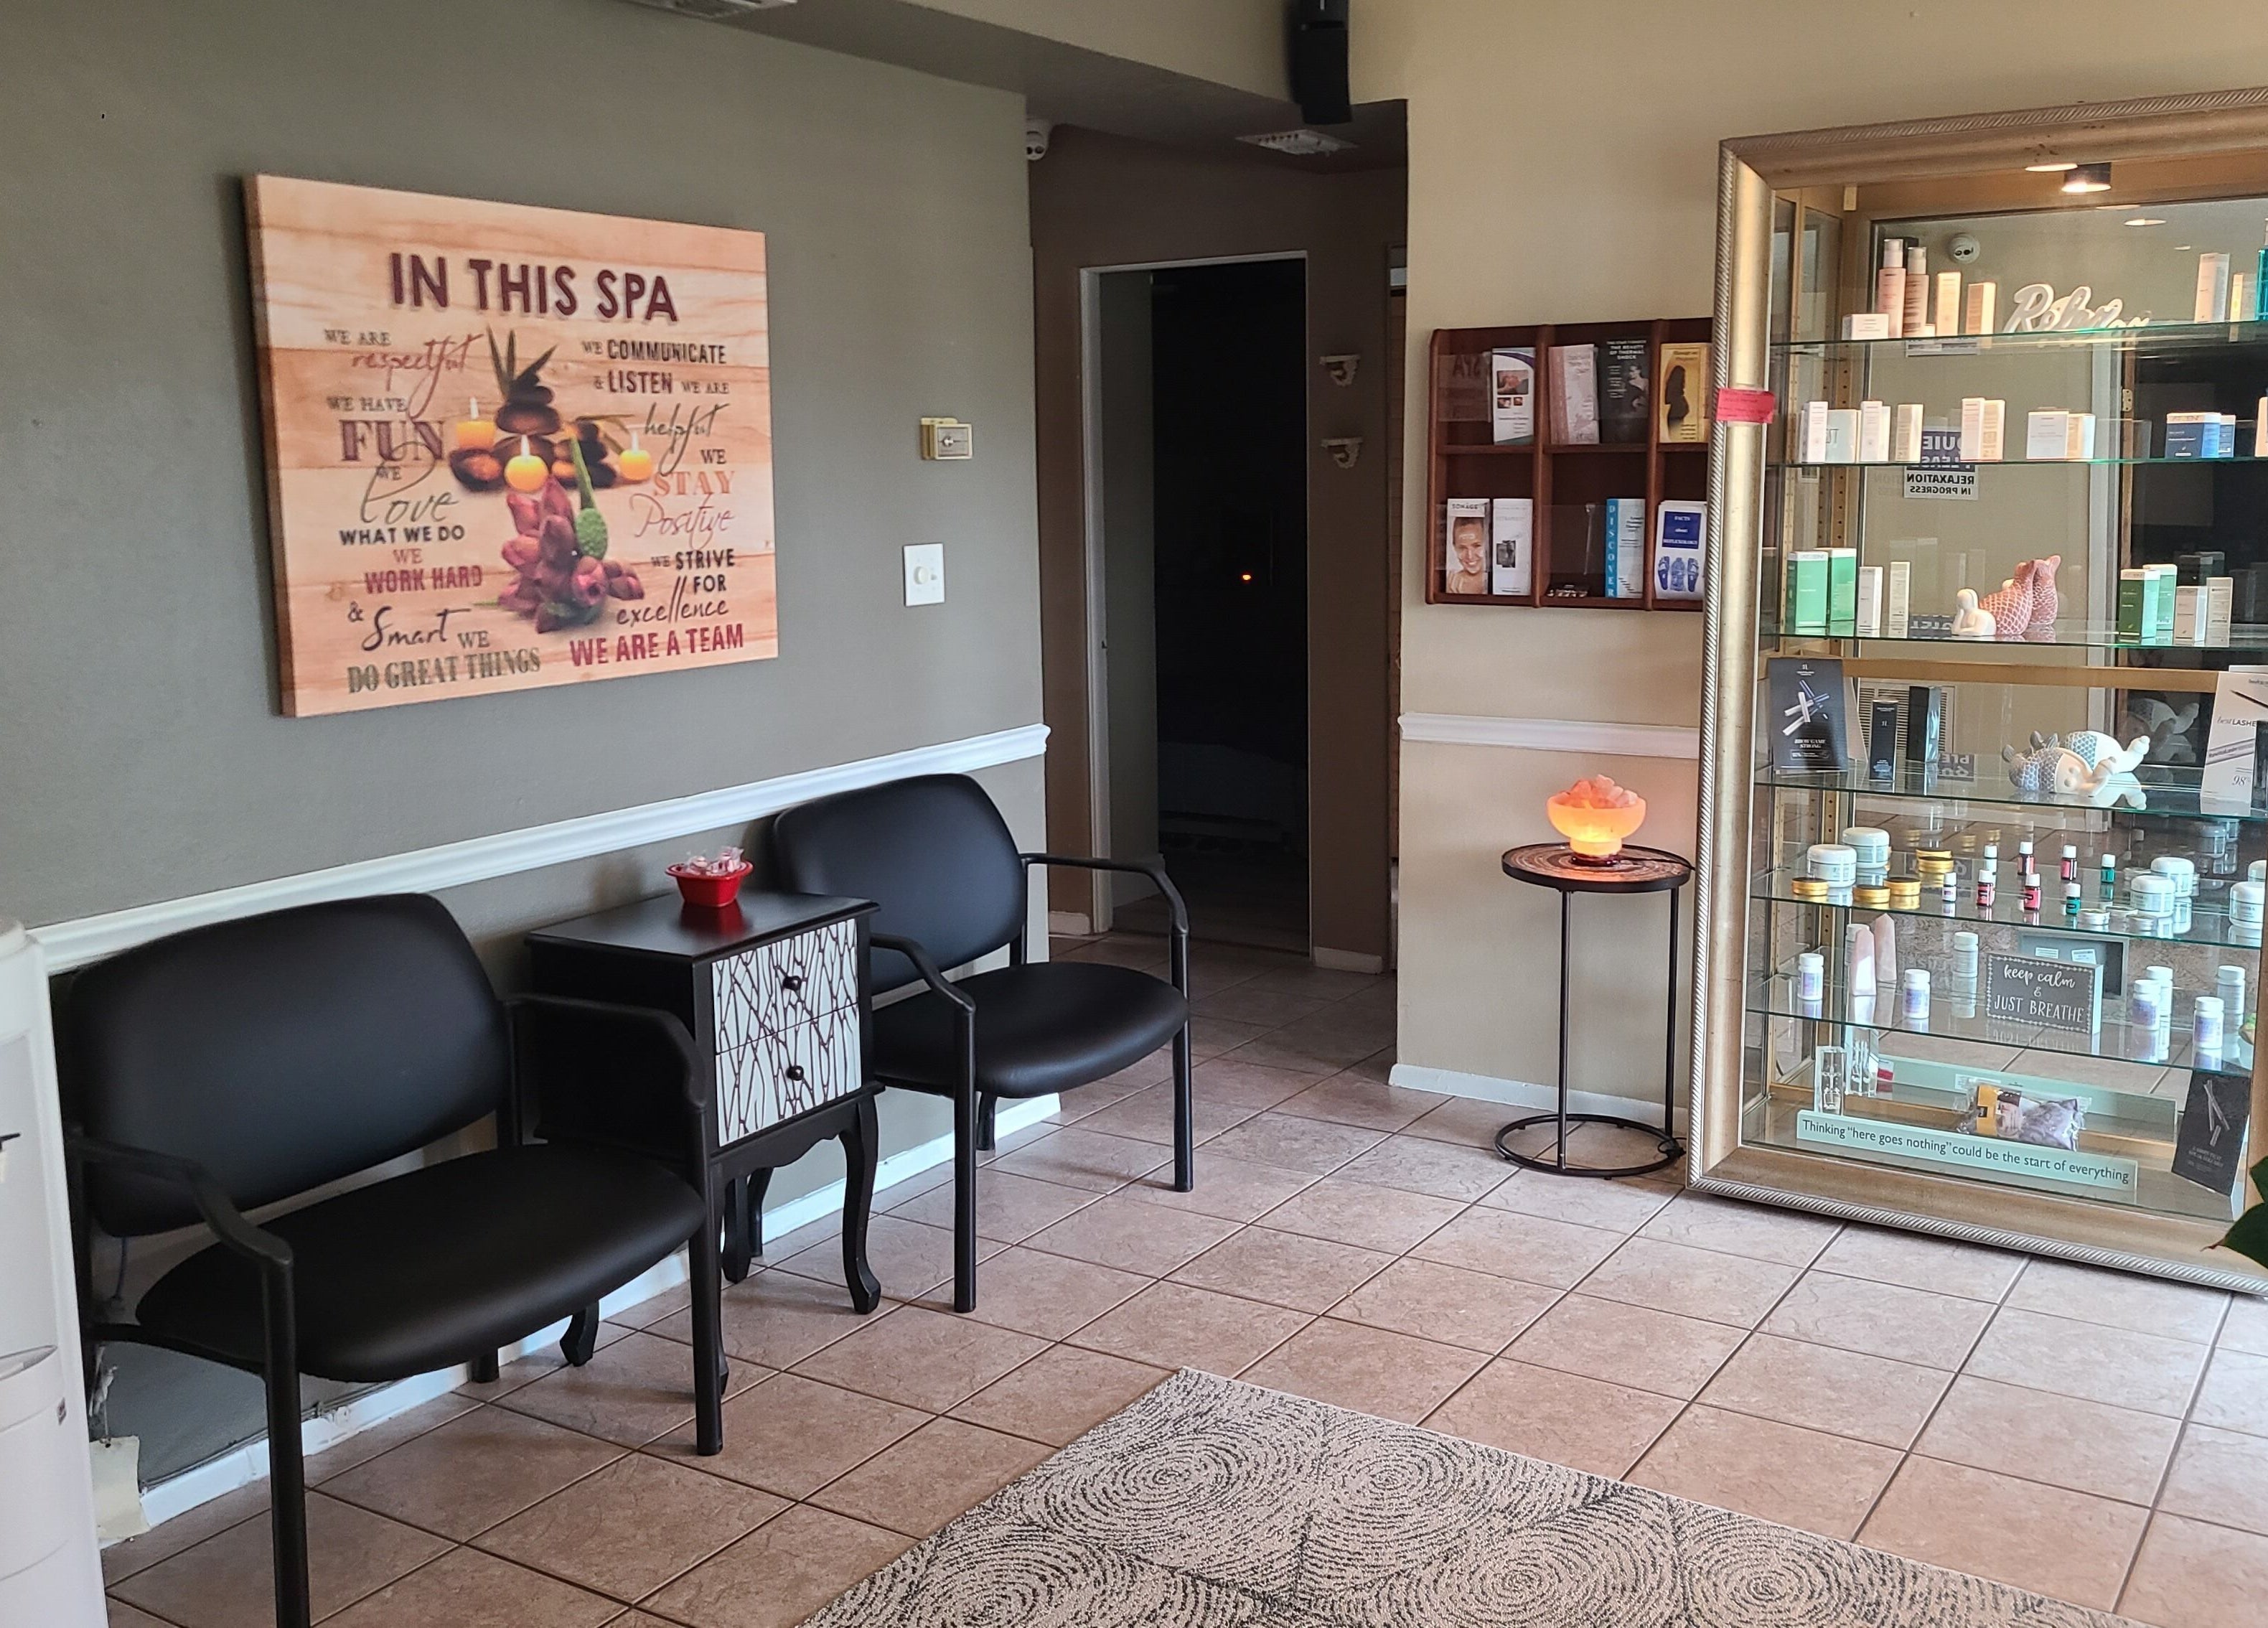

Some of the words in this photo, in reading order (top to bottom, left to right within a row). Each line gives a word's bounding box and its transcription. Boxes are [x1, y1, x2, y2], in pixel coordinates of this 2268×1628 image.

[390, 253, 449, 309] IN
[469, 258, 578, 317] THIS
[597, 269, 678, 322] SPA
[324, 329, 351, 345] WE
[359, 331, 392, 347] ARE
[582, 341, 602, 355] WE
[607, 339, 727, 364] COMMUNICATE
[593, 375, 604, 390] &
[608, 370, 673, 394] LISTEN
[682, 381, 700, 393] WE
[705, 382, 730, 394] ARE
[327, 396, 353, 412] WE
[359, 396, 408, 413] HAVE
[339, 419, 445, 462] FUN
[699, 449, 728, 464] WE
[377, 466, 402, 482] WE
[653, 470, 735, 497] STAY
[629, 492, 735, 551] Positive
[339, 528, 397, 546] WHAT
[403, 526, 432, 543] WE
[438, 525, 465, 541] DO
[393, 548, 423, 564] WE
[651, 555, 671, 568] WE
[675, 548, 735, 571] STRIVE
[365, 569, 426, 594] WORK
[431, 564, 484, 589] HARD
[693, 574, 727, 595] FOR
[616, 576, 730, 627] excellence
[347, 601, 365, 623] &
[361, 606, 472, 651] Smart
[457, 630, 491, 649] WE
[569, 637, 609, 667] WE
[616, 632, 659, 663] ARE
[666, 630, 681, 656] A
[685, 623, 744, 655] TEAM
[347, 663, 380, 693] DO
[384, 656, 460, 689] GREAT
[464, 647, 542, 680] THINGS
[2004, 964, 2033, 986] keep
[2038, 970, 2076, 988] calm
[2033, 986, 2042, 998] &
[1995, 994, 2024, 1013] JUST
[2029, 1000, 2085, 1023] BREATHE
[1802, 1119, 1846, 1140] Thinking
[1879, 1133, 1903, 1146] goes
[1952, 1145, 1982, 1158] could
[1985, 1148, 2000, 1161] be
[2002, 1151, 2021, 1164] the
[2024, 1154, 2051, 1169] start
[2053, 1159, 2068, 1171] of
[2069, 1163, 2130, 1184] everything
